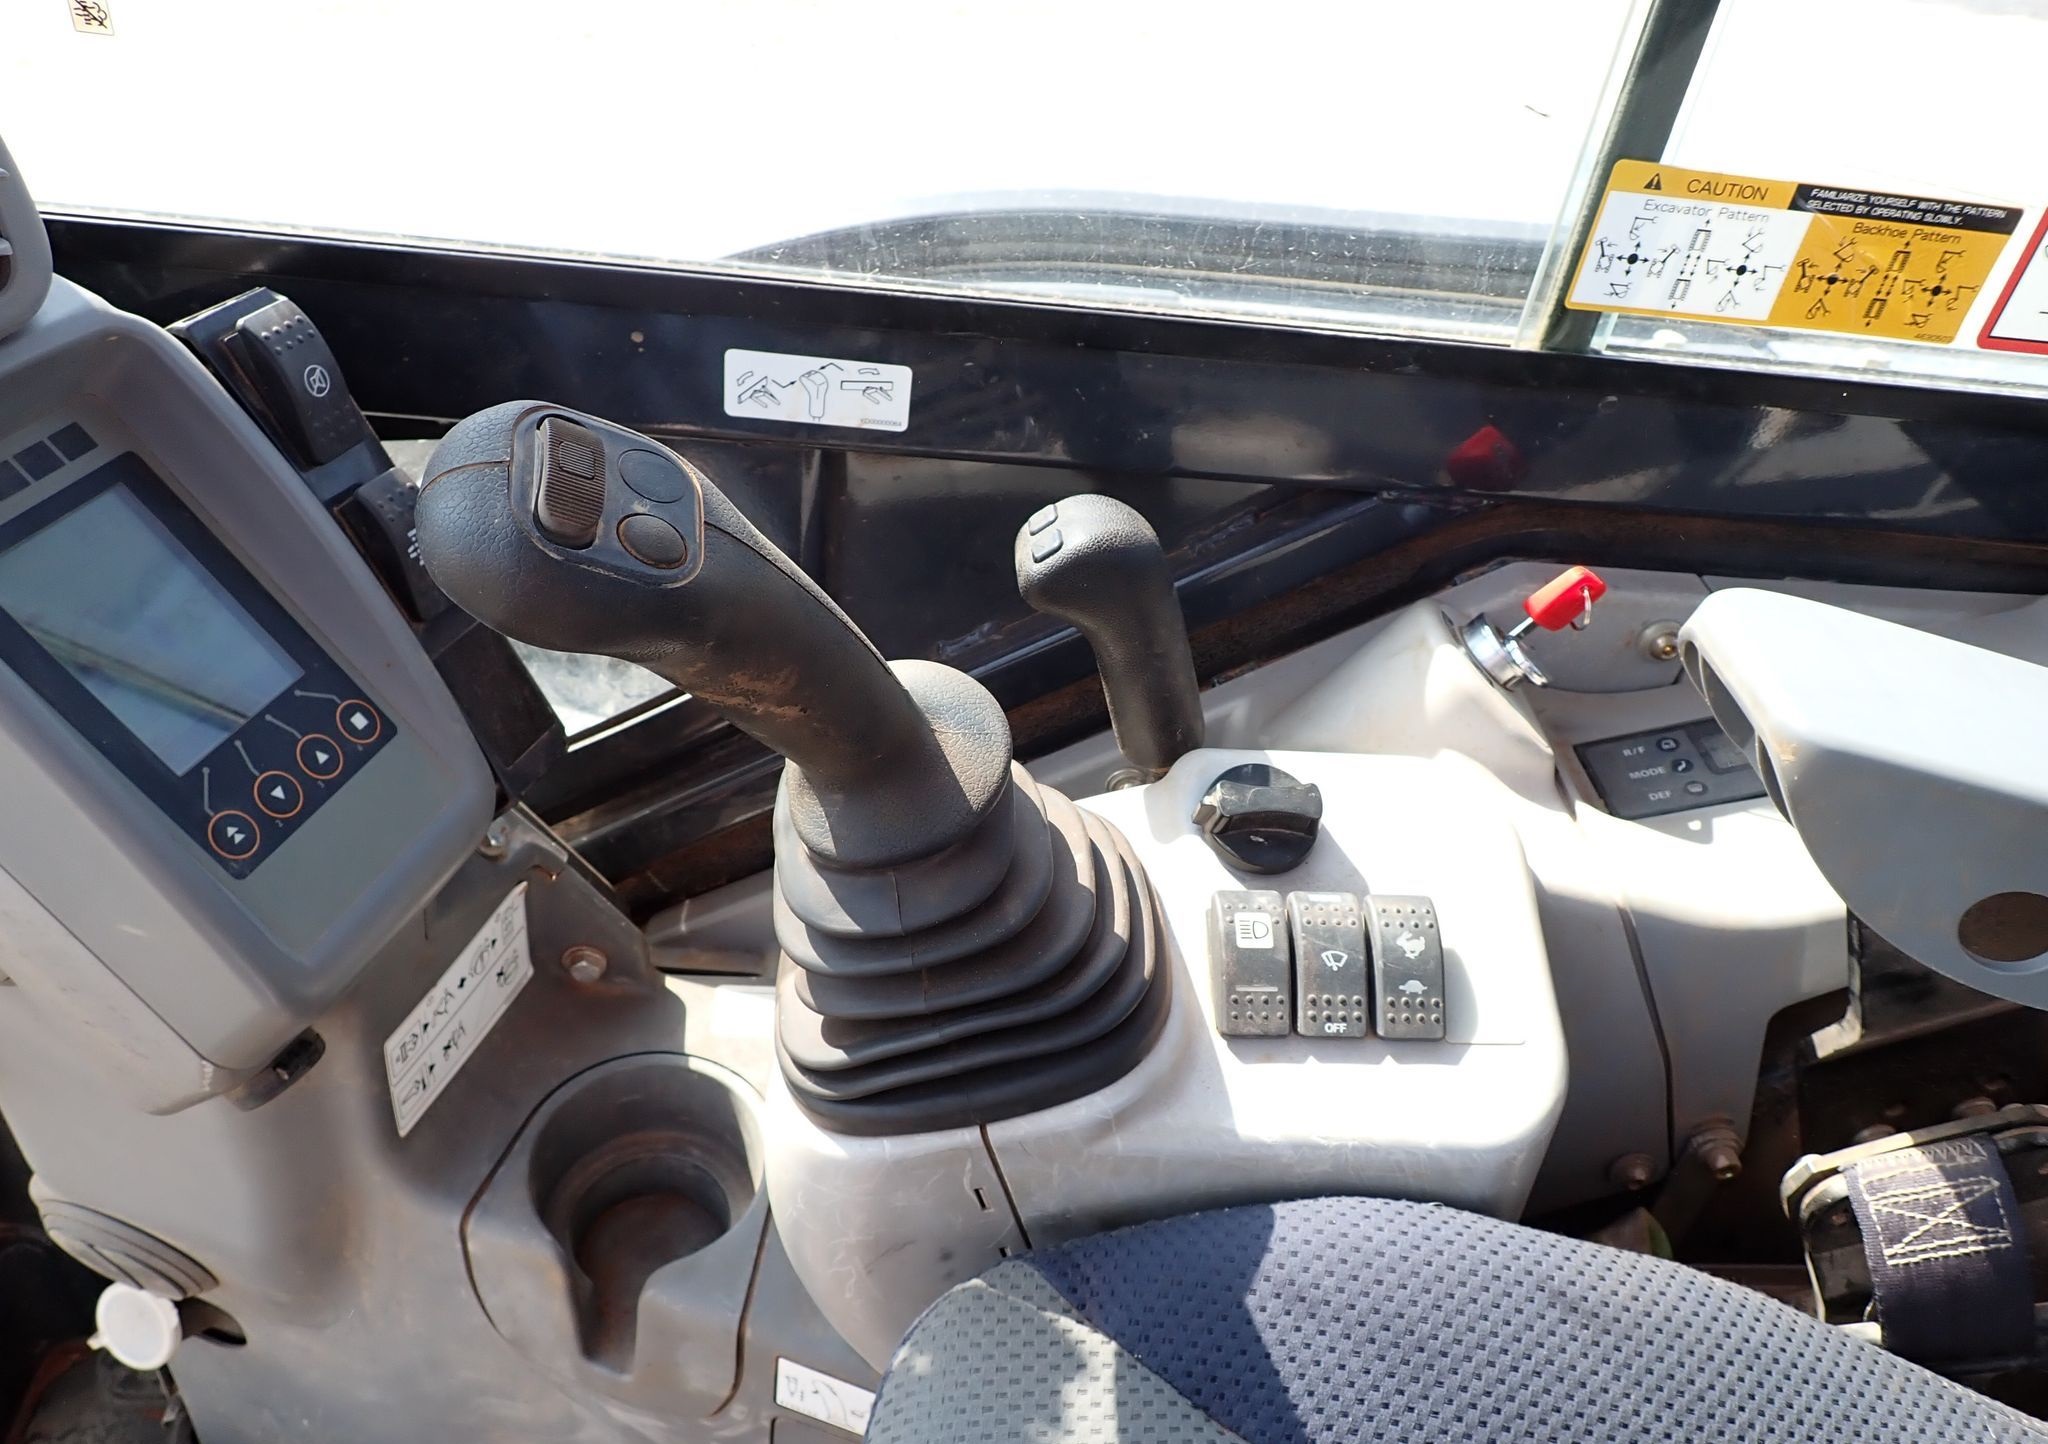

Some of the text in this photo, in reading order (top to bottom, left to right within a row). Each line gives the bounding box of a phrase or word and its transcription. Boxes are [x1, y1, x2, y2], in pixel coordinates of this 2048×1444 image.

[1686, 178, 1769, 201] CAUTION
[1643, 199, 1769, 223] Excavator Pattern
[1806, 199, 1963, 225] SELECTED BY OPERATING SLOWLY.
[1810, 188, 2007, 219] FAMILIARIZE YOURSELF WITH THE PATTERN
[1853, 221, 1962, 244] Backhoe Pattern
[1623, 745, 1646, 757] R/F
[1629, 766, 1666, 780] MODE
[1648, 789, 1672, 801] DEF
[1324, 1022, 1347, 1034] OFF
